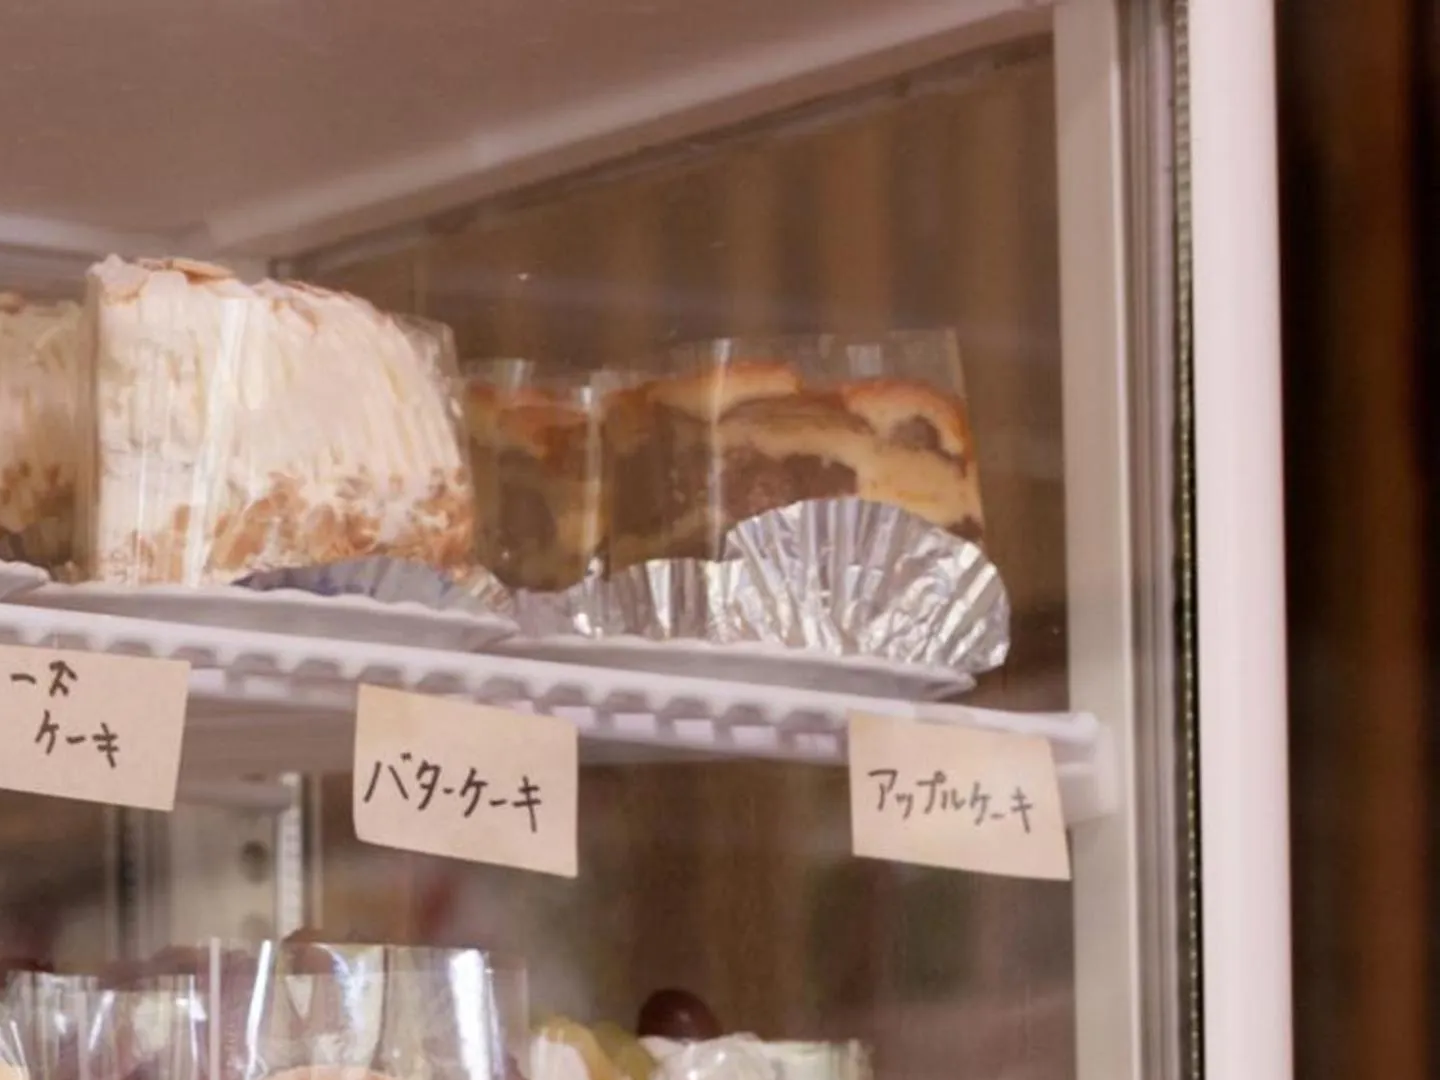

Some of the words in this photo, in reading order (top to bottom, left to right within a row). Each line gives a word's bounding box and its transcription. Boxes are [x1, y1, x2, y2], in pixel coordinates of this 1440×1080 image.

[34, 709, 120, 769] ケーキ
[363, 751, 542, 834] バターケーキ
[867, 768, 1034, 835] アップルケーキ
